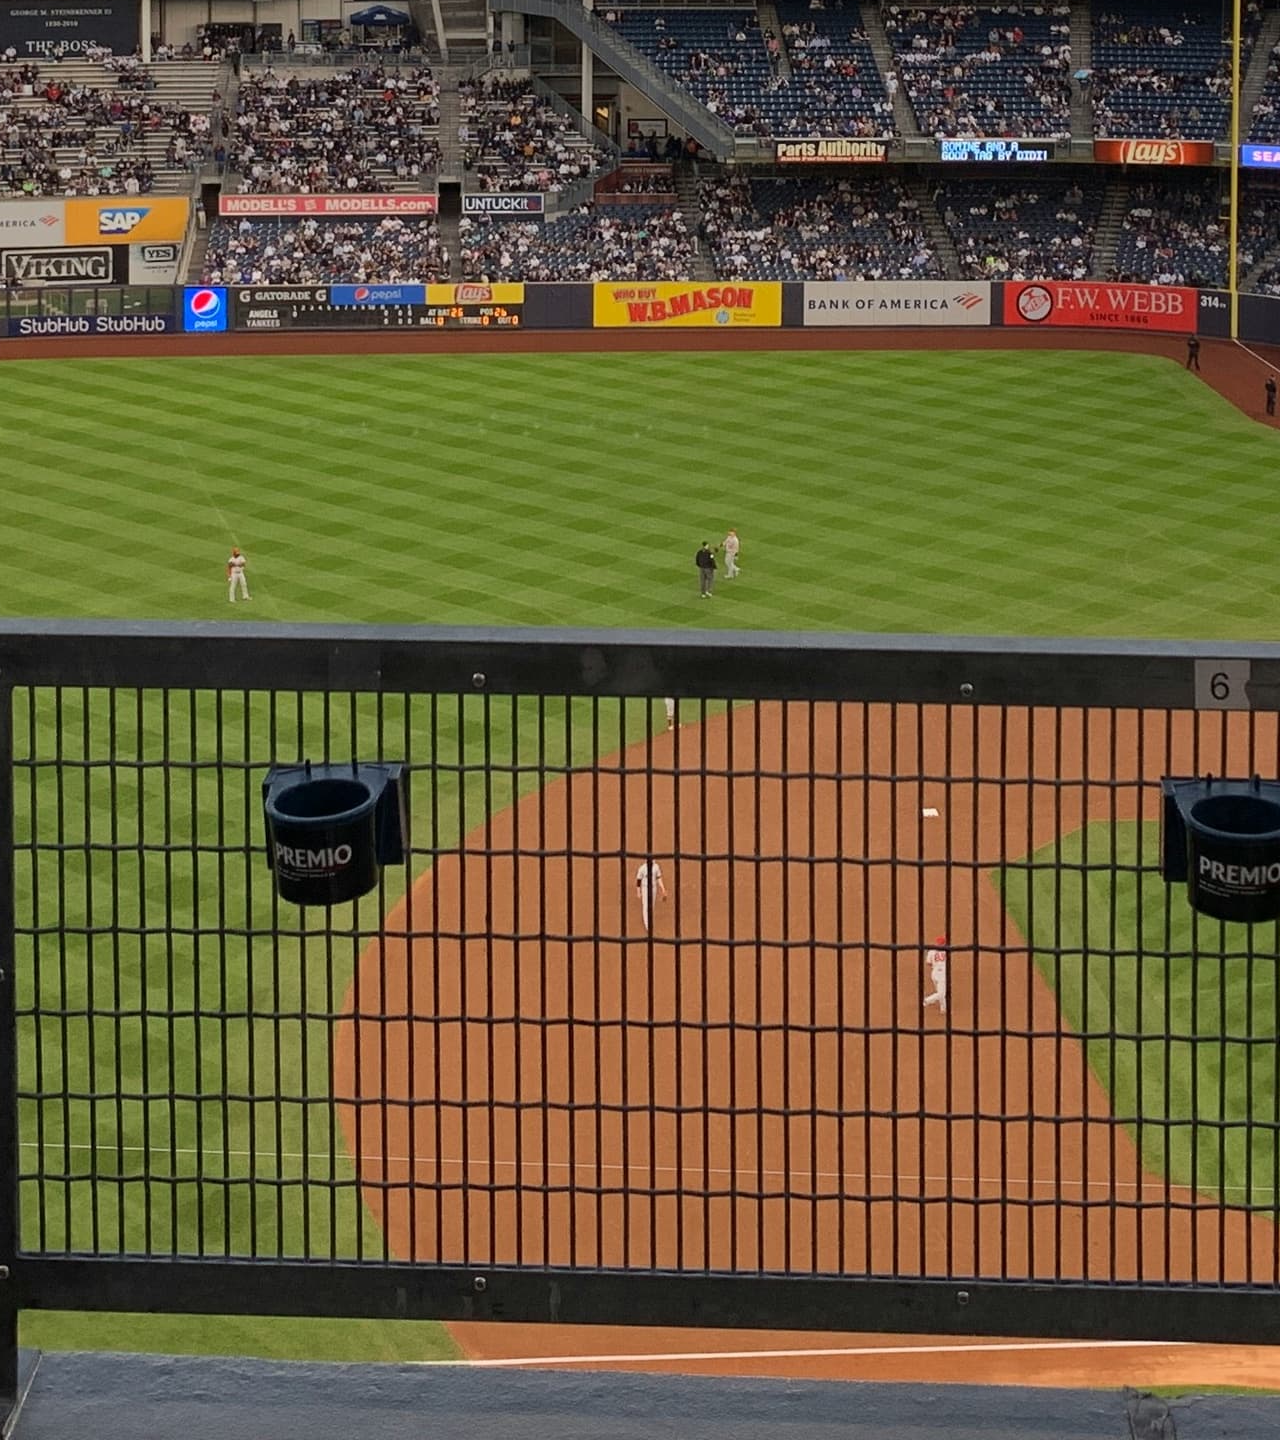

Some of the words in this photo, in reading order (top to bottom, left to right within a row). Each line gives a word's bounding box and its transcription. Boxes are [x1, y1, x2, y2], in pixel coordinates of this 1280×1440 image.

[9, 9, 38, 17] GEORGE
[25, 40, 55, 53] THE
[60, 40, 97, 53] BOSS
[777, 142, 815, 157] Parts
[818, 140, 886, 157] Authority
[941, 141, 982, 151] ROMINE
[986, 141, 1007, 151] AND
[1010, 141, 1019, 151] A
[941, 151, 968, 160] GOOD
[972, 151, 993, 160] TAG
[997, 151, 1011, 160] BY
[228, 199, 296, 211] MODELL'S
[326, 199, 431, 211] MODELLS.com
[465, 197, 529, 210] UNTUCKit
[99, 212, 142, 231] SAP
[146, 248, 172, 258] YES
[9, 255, 106, 279] VIKING
[239, 290, 251, 302] G
[255, 291, 311, 301] GATORADE
[315, 289, 327, 302] G
[371, 289, 401, 300] pepsi
[627, 286, 754, 323] W.B.MASON
[808, 299, 850, 310] BANK
[855, 299, 874, 309] OF
[879, 299, 949, 310] AMERICA
[1056, 288, 1100, 310] F.W.
[1106, 289, 1184, 315] WEBB
[248, 310, 278, 318] ANGELS
[428, 308, 437, 316] AT
[437, 308, 450, 316] BAT
[480, 308, 493, 316] POS
[1089, 313, 1121, 322] SINCE
[20, 317, 90, 334] StubHub
[96, 316, 166, 332] StubHub
[194, 318, 218, 330] pepsi
[247, 319, 280, 328] YANKEES
[420, 317, 436, 325] BALL
[436, 316, 444, 326] 0
[482, 316, 489, 326] 0
[497, 317, 511, 325] OUT
[511, 316, 518, 325] 0
[1210, 672, 1231, 700] 6
[275, 841, 352, 868] PREMIO
